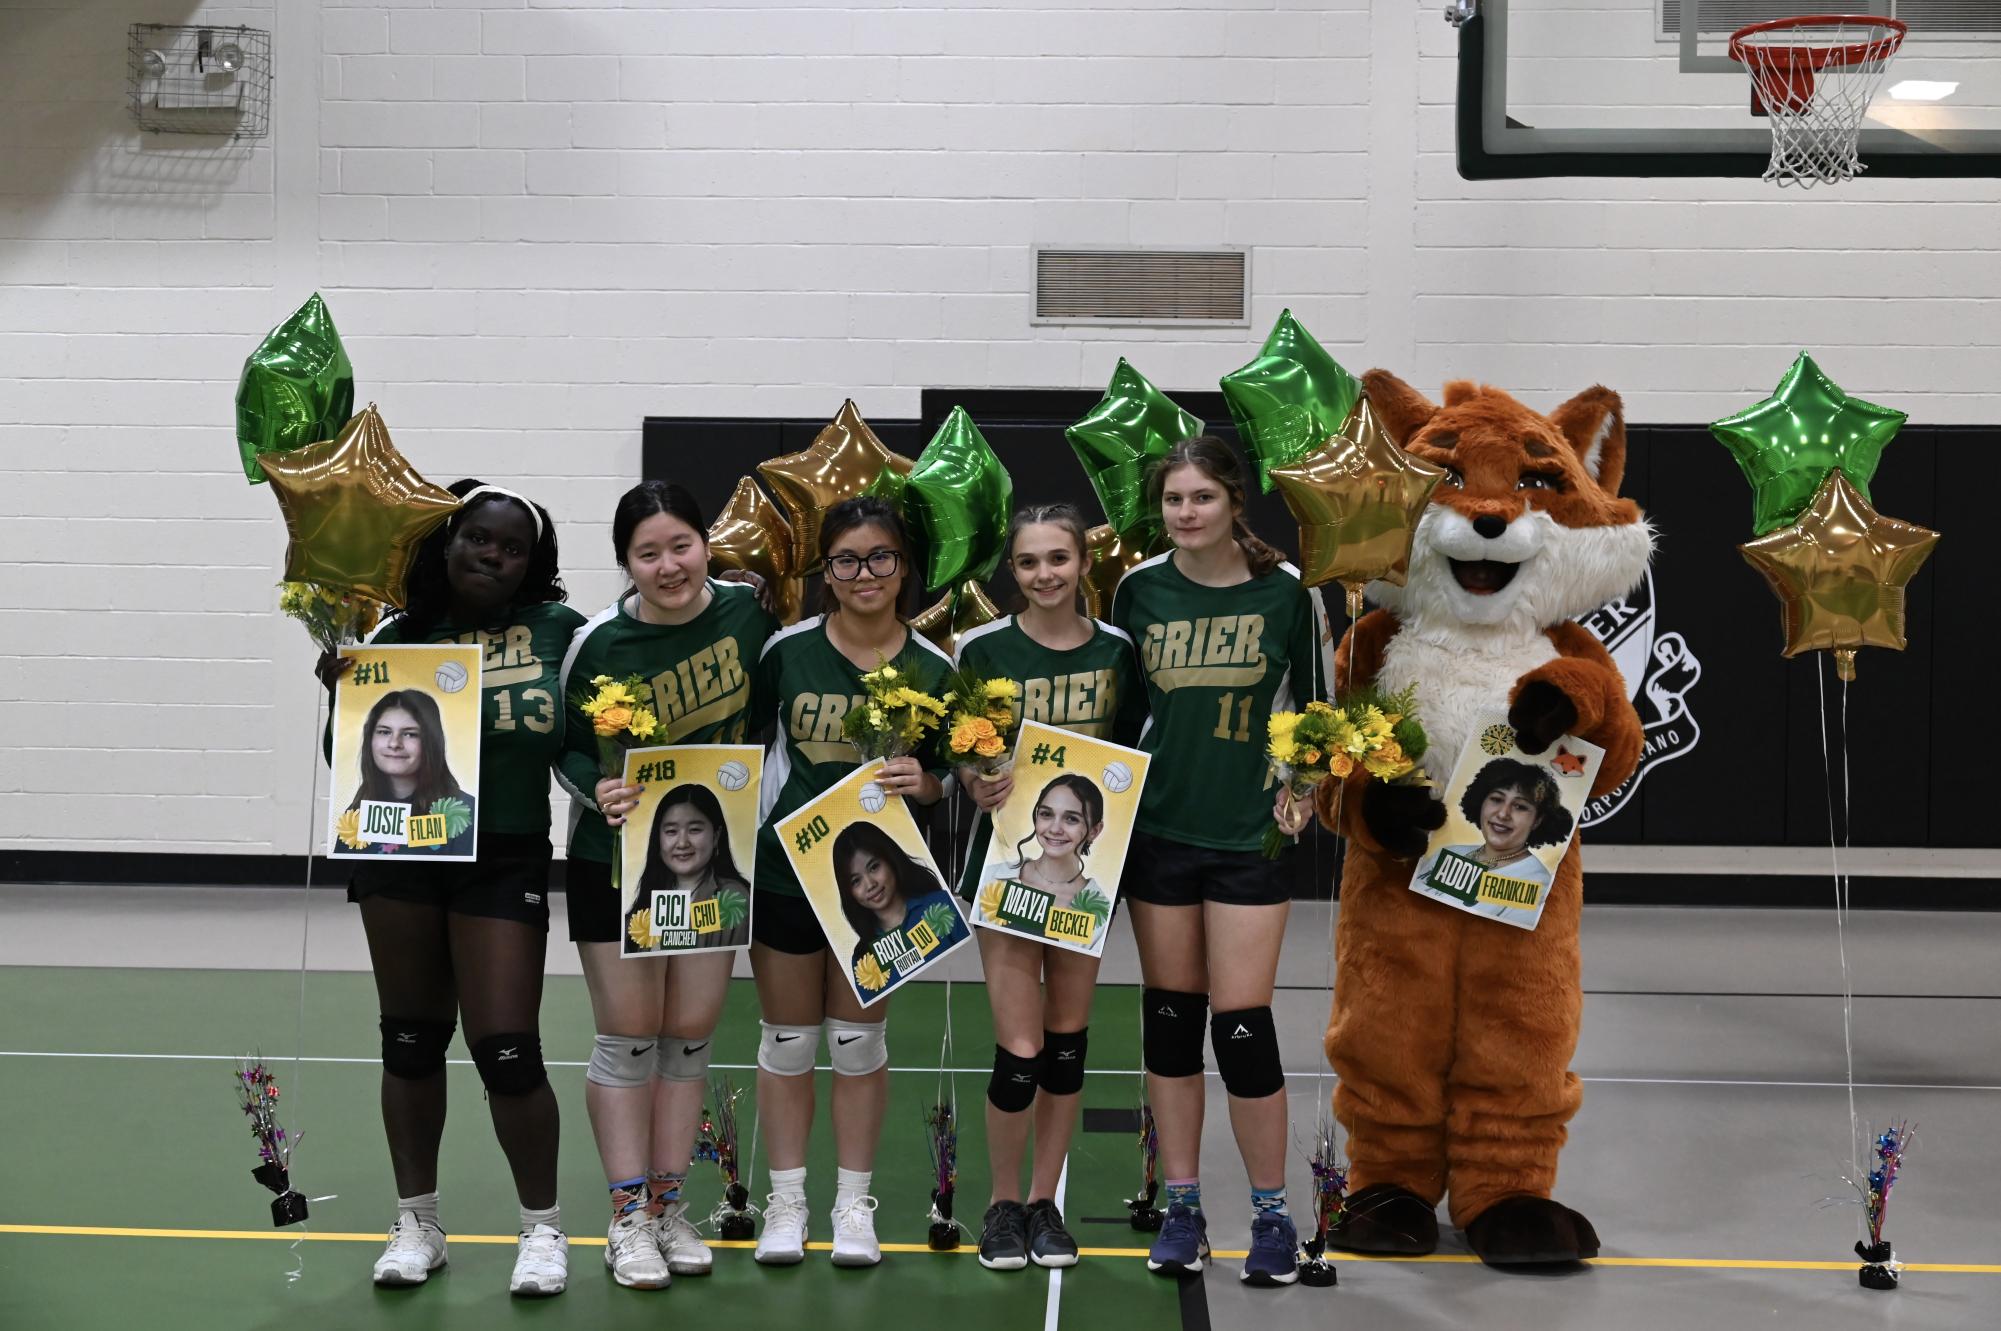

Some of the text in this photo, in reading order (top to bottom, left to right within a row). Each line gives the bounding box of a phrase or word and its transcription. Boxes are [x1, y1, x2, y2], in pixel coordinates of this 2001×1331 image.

[1142, 614, 1265, 672] GRIER
[353, 661, 390, 685] #11
[493, 688, 555, 734] 13
[1213, 692, 1253, 742] 11
[636, 760, 676, 783] #18
[1031, 742, 1067, 768] #4
[363, 804, 443, 841] JOSIE FILAN
[795, 814, 830, 854] #10
[1434, 854, 1539, 905] ADDY FRANKLIN
[655, 894, 716, 928] CICI CHU
[1002, 884, 1091, 938] MAYA BECKEL
[662, 931, 697, 946] CANCHEN
[873, 924, 933, 965] ROXY LIU
[896, 949, 921, 972] RUIYAN
